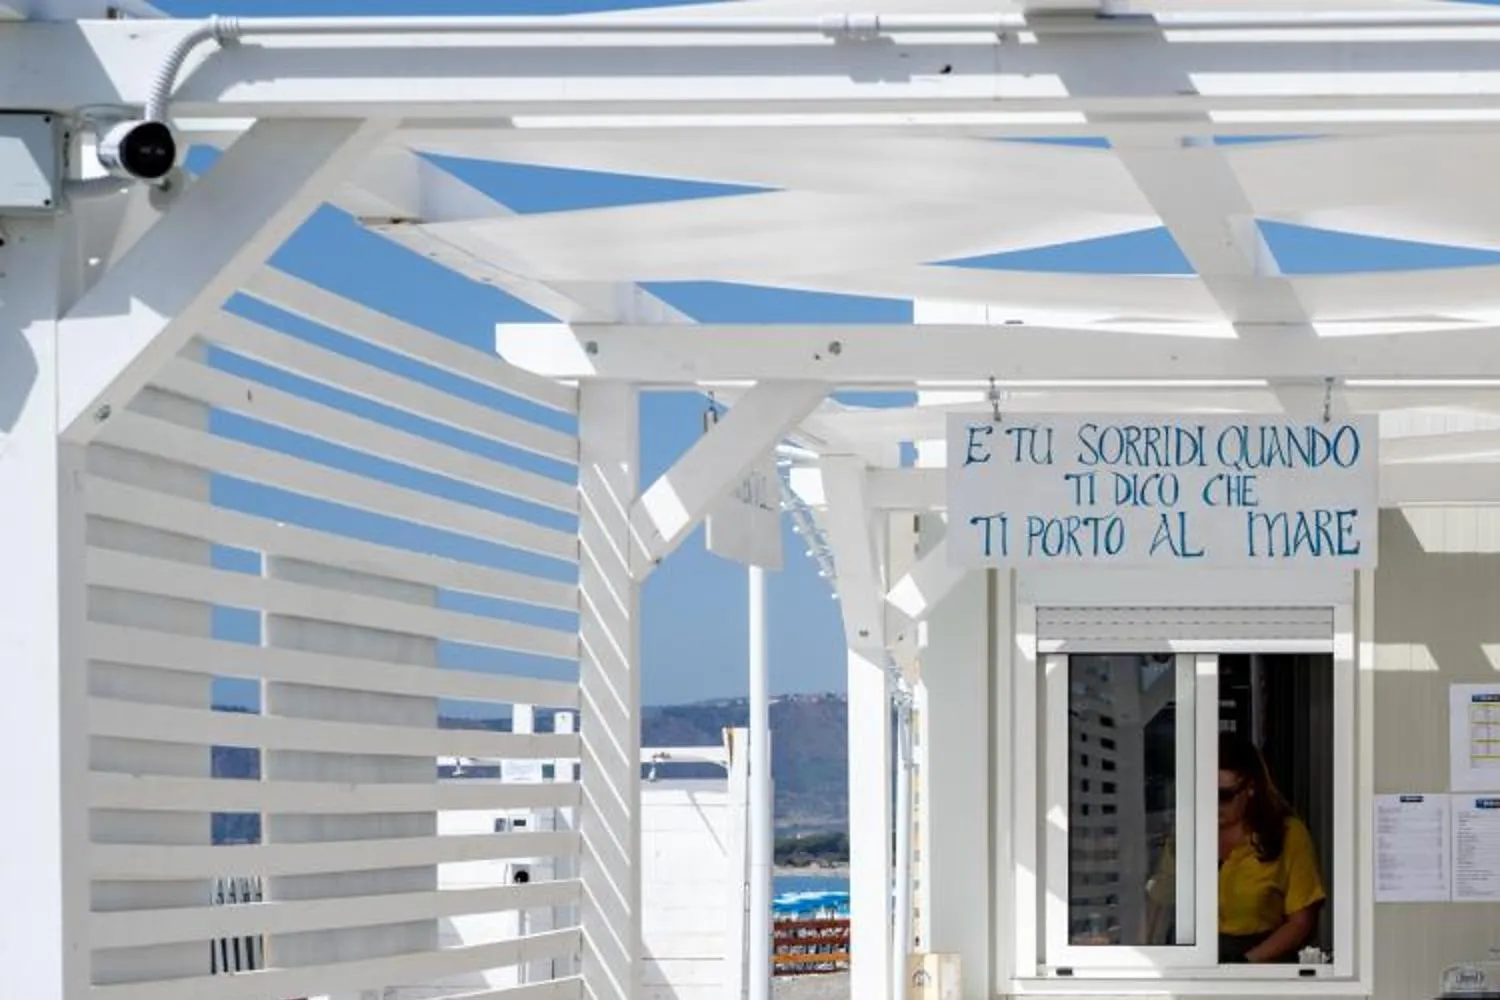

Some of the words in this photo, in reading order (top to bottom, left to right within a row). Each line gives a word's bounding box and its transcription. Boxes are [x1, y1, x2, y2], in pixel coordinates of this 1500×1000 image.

[1005, 426, 1053, 465] TU
[1077, 422, 1208, 467] SORRIDI
[1216, 424, 1361, 471] QUANDO
[1064, 470, 1096, 507] TI
[1112, 471, 1180, 507] DICO
[1202, 472, 1260, 508] CHE
[969, 511, 1009, 557] TI
[1026, 511, 1125, 557] PORTO
[1149, 510, 1206, 558] AL
[1247, 508, 1362, 557] MARE
